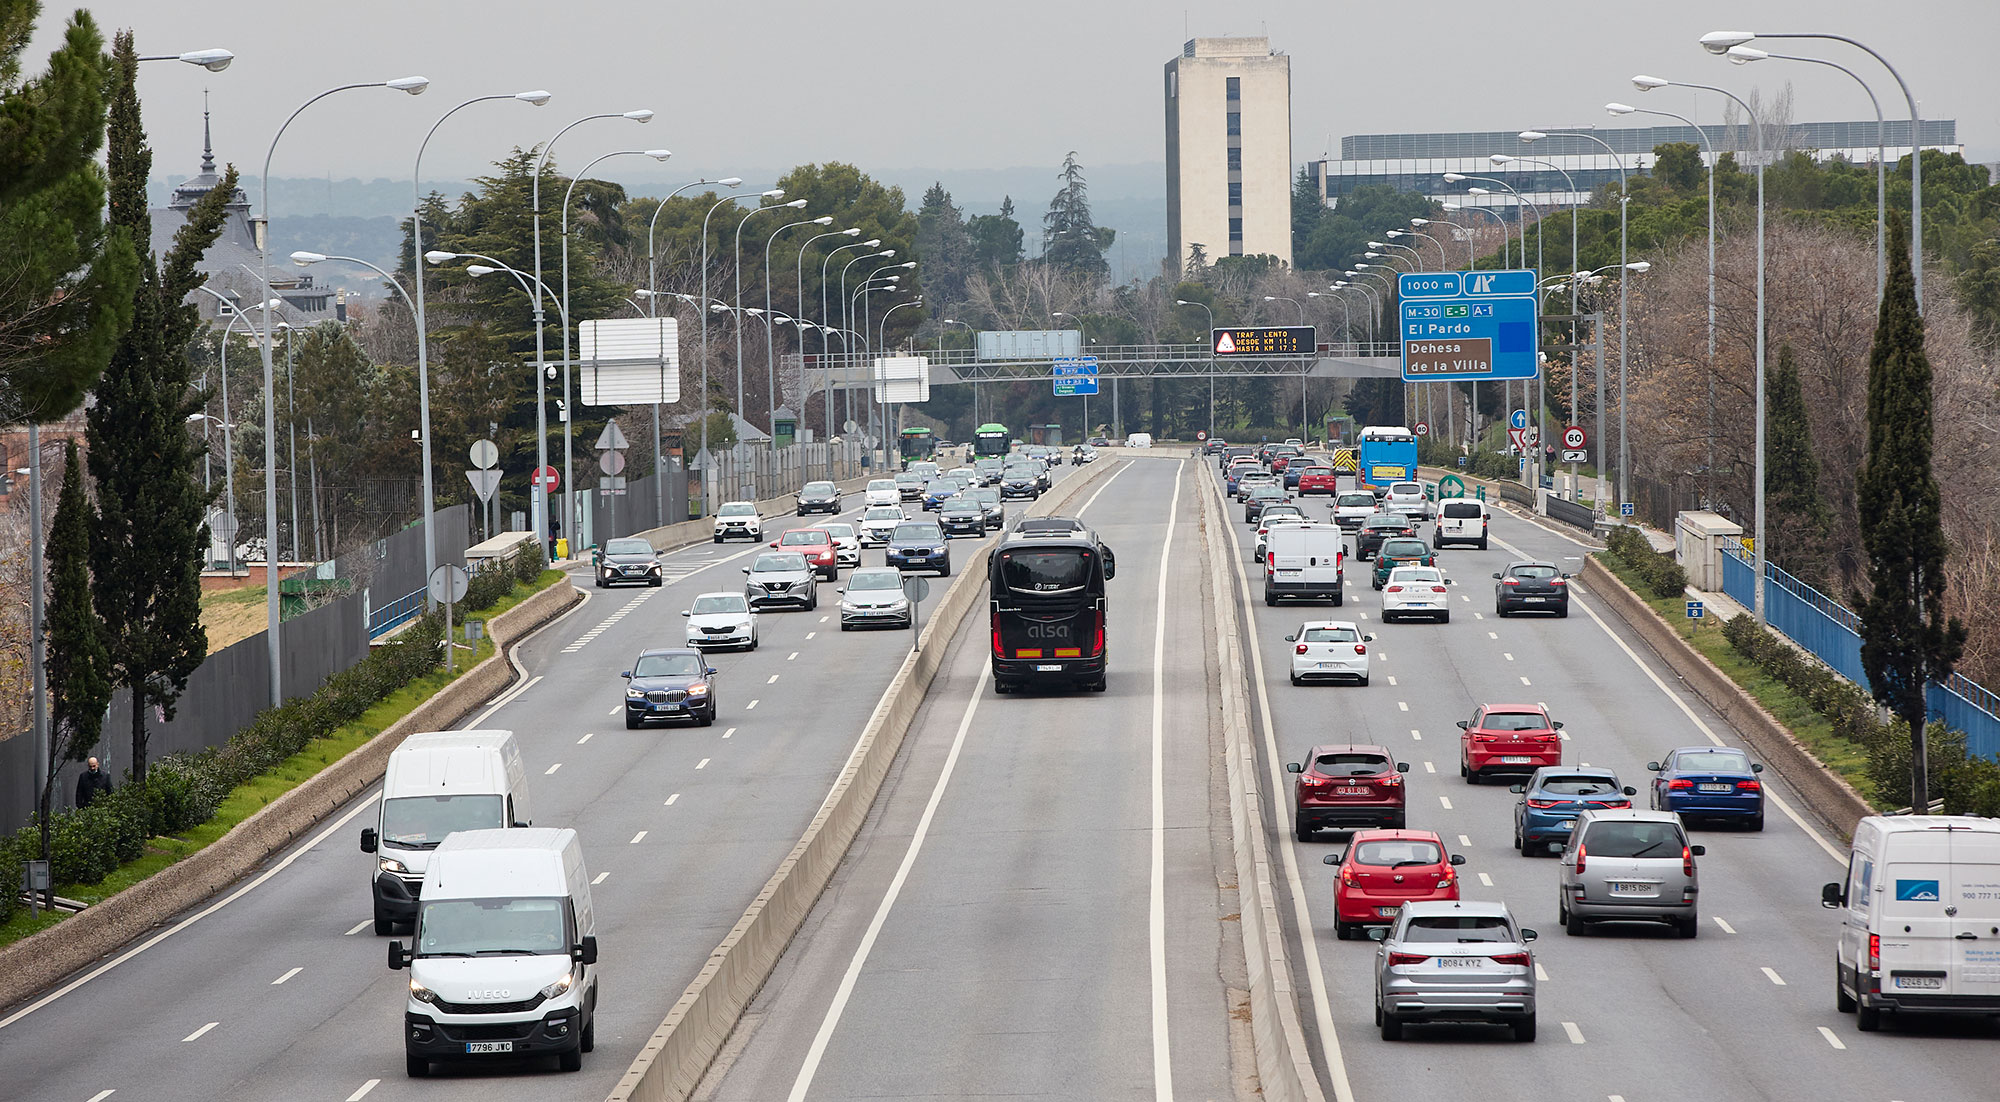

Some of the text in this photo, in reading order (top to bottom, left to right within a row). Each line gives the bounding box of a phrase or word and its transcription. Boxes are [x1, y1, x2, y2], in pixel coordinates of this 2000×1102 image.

[1407, 281, 1439, 290] 1000
[1408, 306, 1493, 317] M-30 E-5 A-1
[1409, 323, 1471, 335] El Pardo
[1410, 343, 1461, 354] Dehesa
[1411, 360, 1487, 372] de la Villa
[1568, 434, 1582, 442] 60
[1691, 609, 1699, 617] 8
[1027, 624, 1069, 638] alsa
[1962, 892, 1976, 900] 900
[1978, 892, 1992, 900] 777
[1442, 959, 1482, 968] 8084 KYZ
[1923, 978, 1940, 986] LPN
[467, 989, 511, 1000] IVECO
[472, 1043, 493, 1052] 7796
